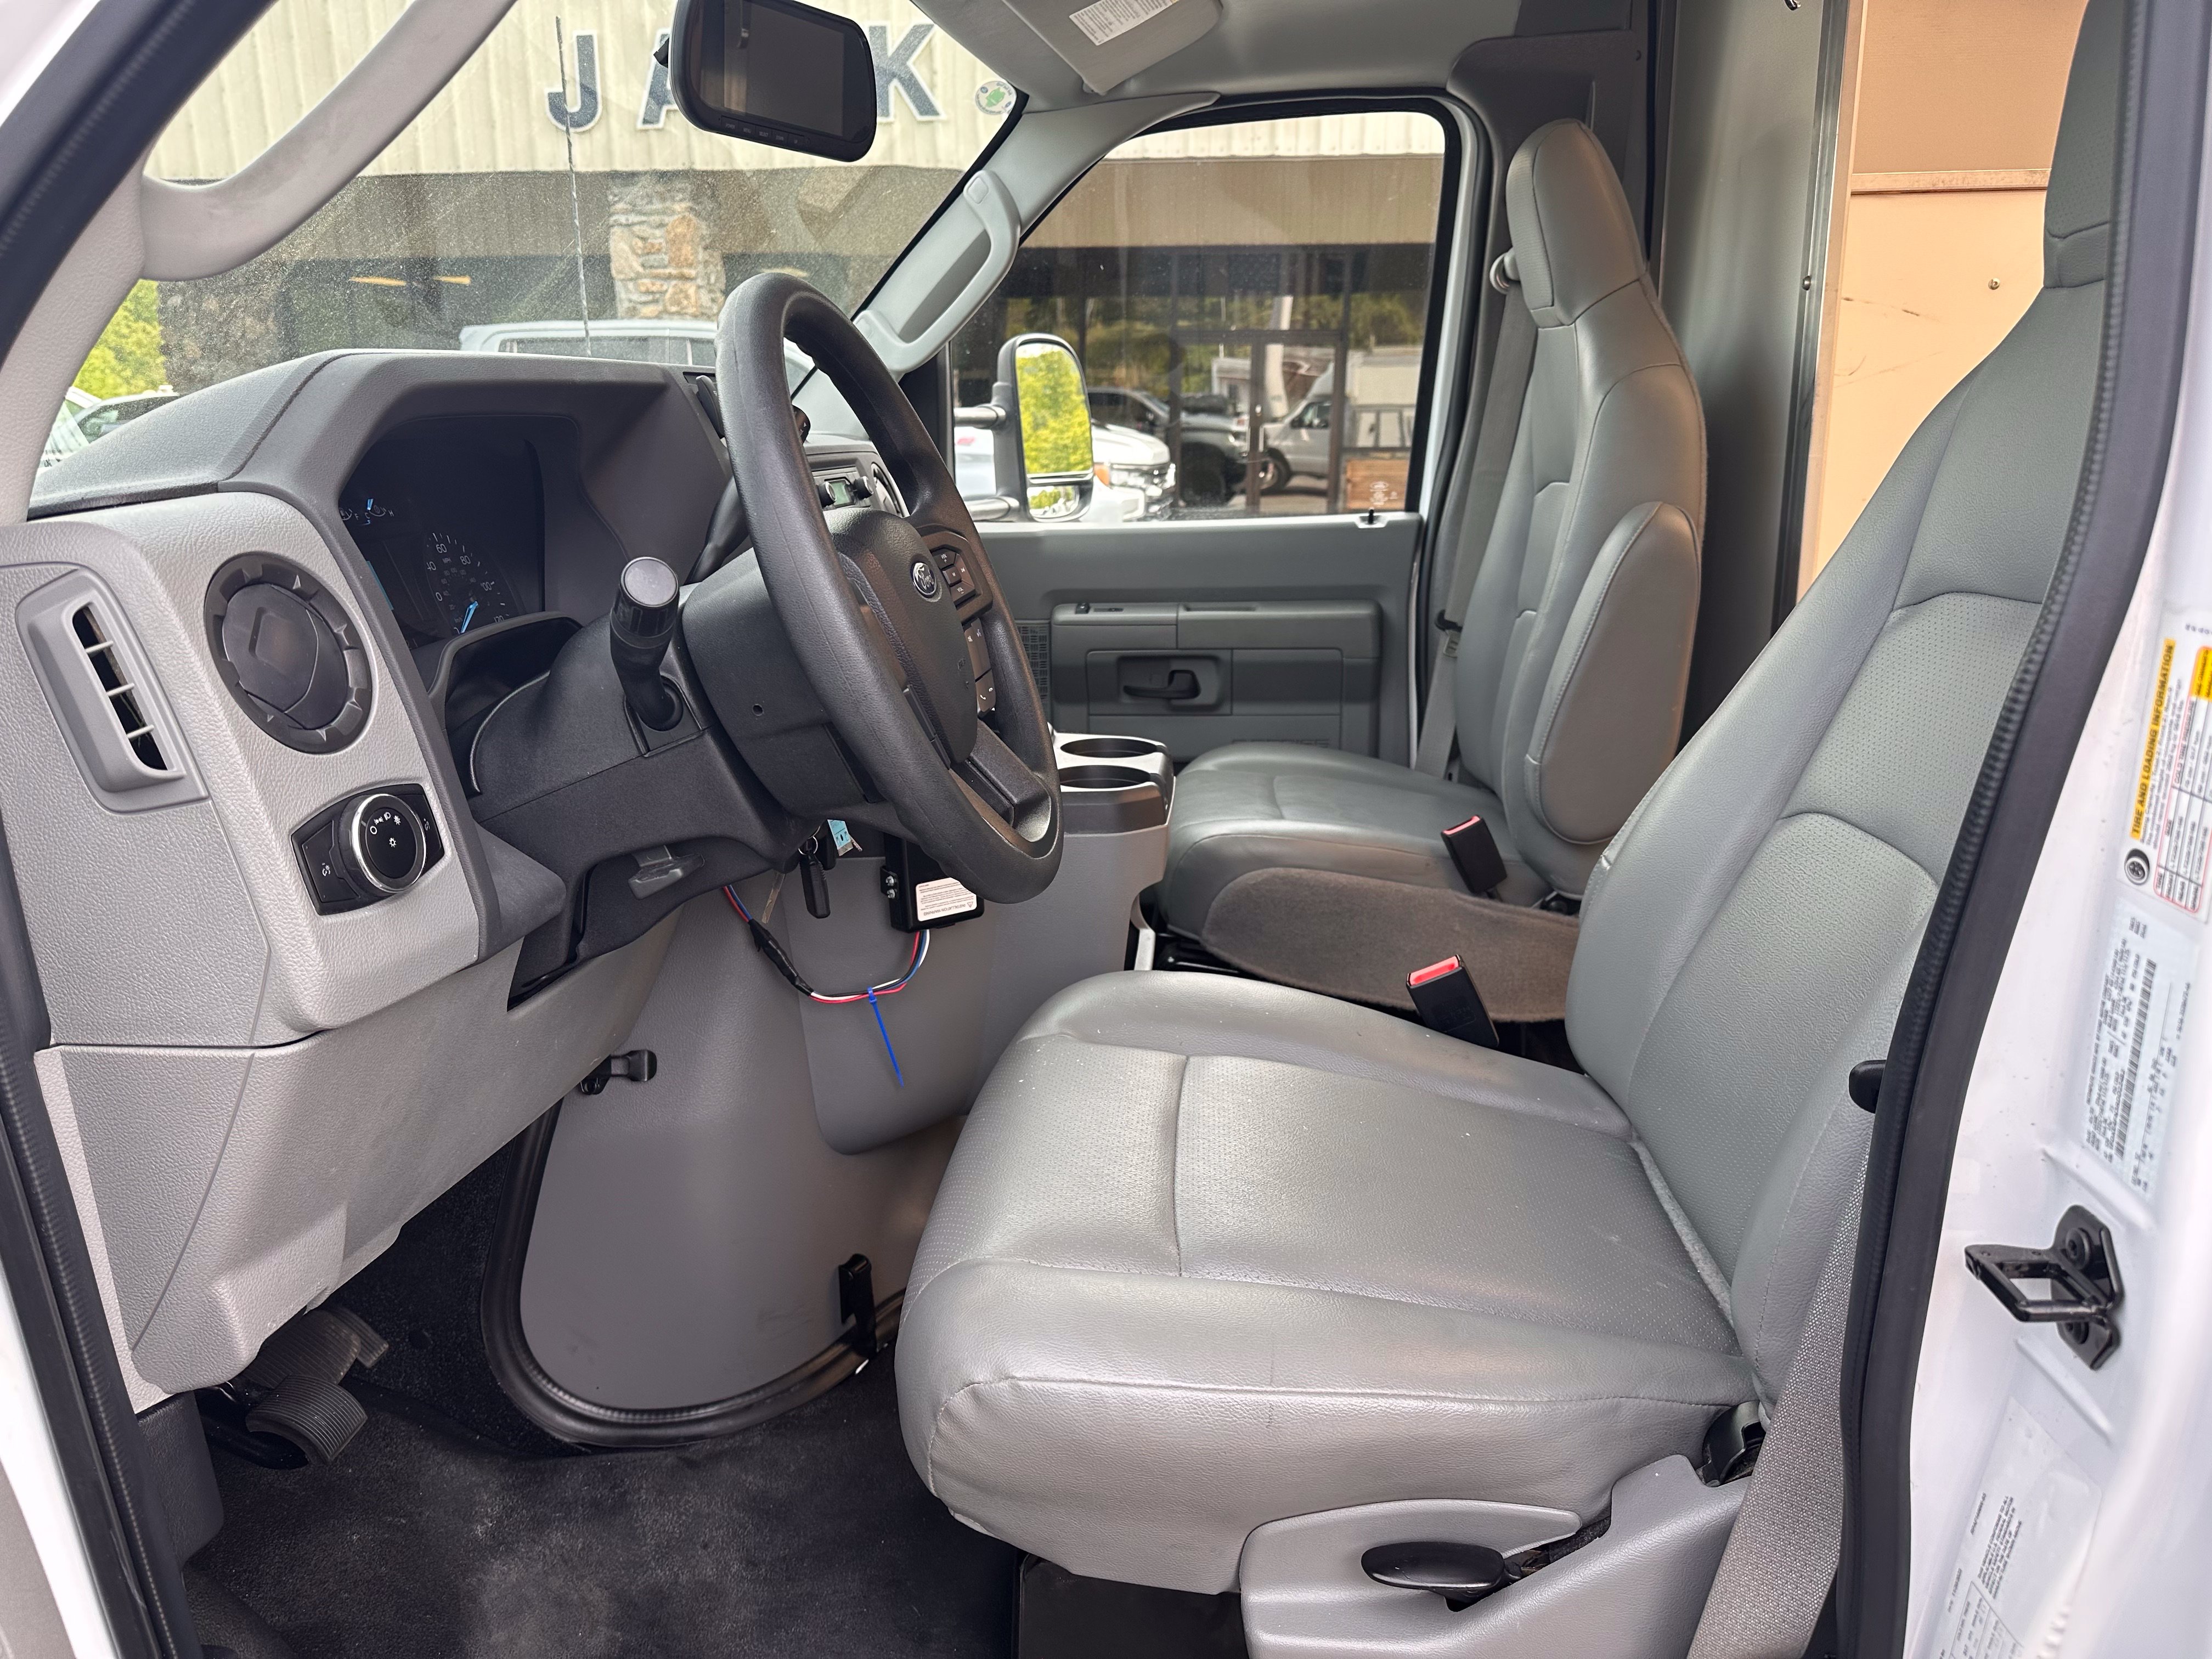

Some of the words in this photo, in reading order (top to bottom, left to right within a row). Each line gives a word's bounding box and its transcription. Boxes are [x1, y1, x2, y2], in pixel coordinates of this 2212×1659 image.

[436, 543, 447, 554] 60
[460, 555, 471, 566] 80
[2151, 642, 2172, 726] INFORMATION
[2141, 727, 2157, 781] LOADING
[2174, 761, 2182, 784] COLD
[2182, 699, 2194, 742] PRESSURE
[2136, 782, 2147, 806] AND
[2131, 808, 2142, 834] TIRE
[2165, 873, 2174, 898] FRONT
[2190, 885, 2198, 911] SPARE
[941, 904, 966, 912] INSTALLATION
[1980, 1552, 1993, 1583] APPLICABLE
[1995, 1517, 2006, 1541] FEDERAL
[2004, 1496, 2013, 1517] MOTOR
[1981, 1543, 1991, 1566] VEHICLE
[1989, 1513, 2001, 1544] CONFORMS
[1984, 1566, 1994, 1588] VEHICLE
[1992, 1545, 2001, 1566] SAFETY
[1999, 1513, 2012, 1545] STANDARDS
[1991, 1559, 2007, 1599] MANUFACTURE
[2006, 1538, 2015, 1559] SHOWN
[1988, 1573, 1996, 1594] EFFECT
